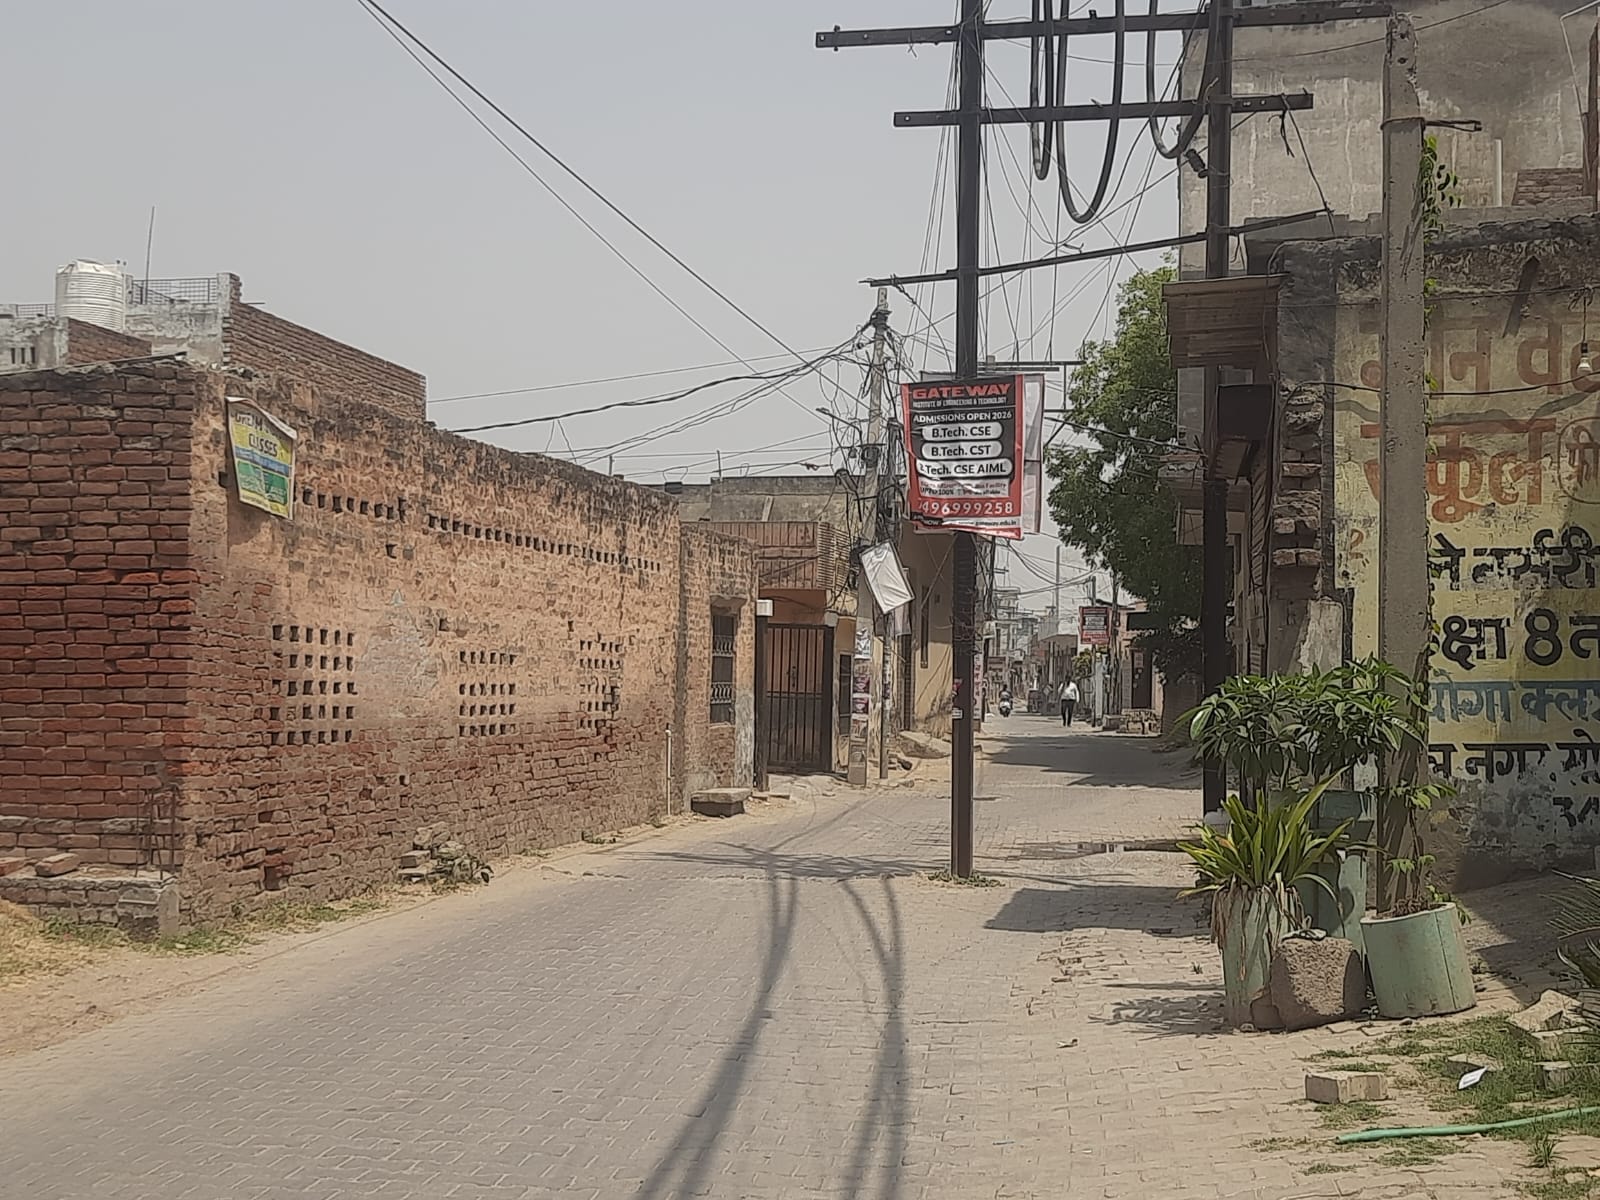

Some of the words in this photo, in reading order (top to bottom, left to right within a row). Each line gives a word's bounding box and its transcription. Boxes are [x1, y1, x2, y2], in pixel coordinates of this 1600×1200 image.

[912, 383, 1011, 400] GATEWAY
[913, 413, 966, 423] ADMISSIONS
[966, 412, 991, 421] OPEN
[931, 426, 968, 438] B.Tech.
[970, 426, 992, 436] CSE
[931, 444, 968, 457] B.Tech.
[969, 444, 992, 455] CST
[953, 464, 975, 474] CSE
[976, 462, 1006, 474] AIML
[918, 501, 1014, 515] 496999258
[1524, 607, 1563, 666] 8
